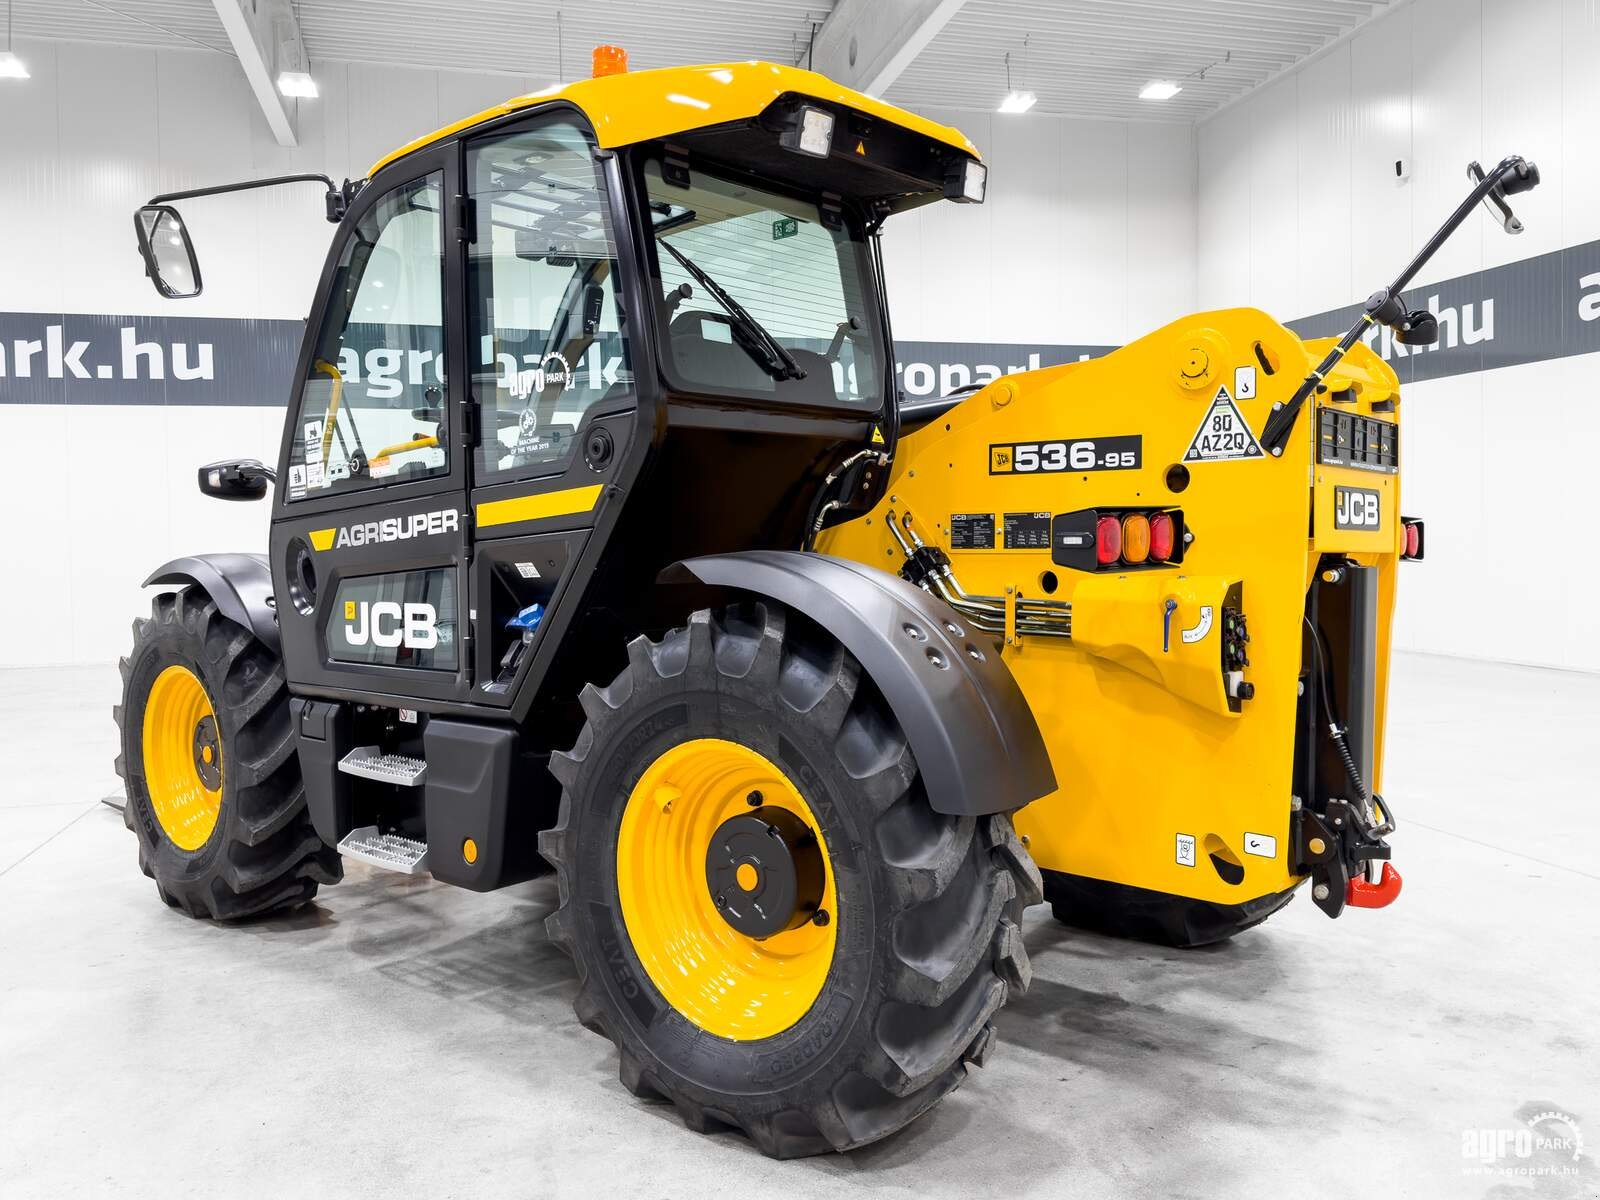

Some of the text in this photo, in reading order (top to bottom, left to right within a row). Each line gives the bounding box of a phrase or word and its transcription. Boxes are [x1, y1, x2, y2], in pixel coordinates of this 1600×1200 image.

[0, 325, 214, 380] rk.hu
[509, 368, 564, 399] agro PARK
[1202, 433, 1244, 452] AZ2Q
[1338, 491, 1378, 525] JCB
[336, 509, 459, 549] AGRISUPER
[344, 601, 438, 650] JCB
[601, 935, 639, 999] CEAT
